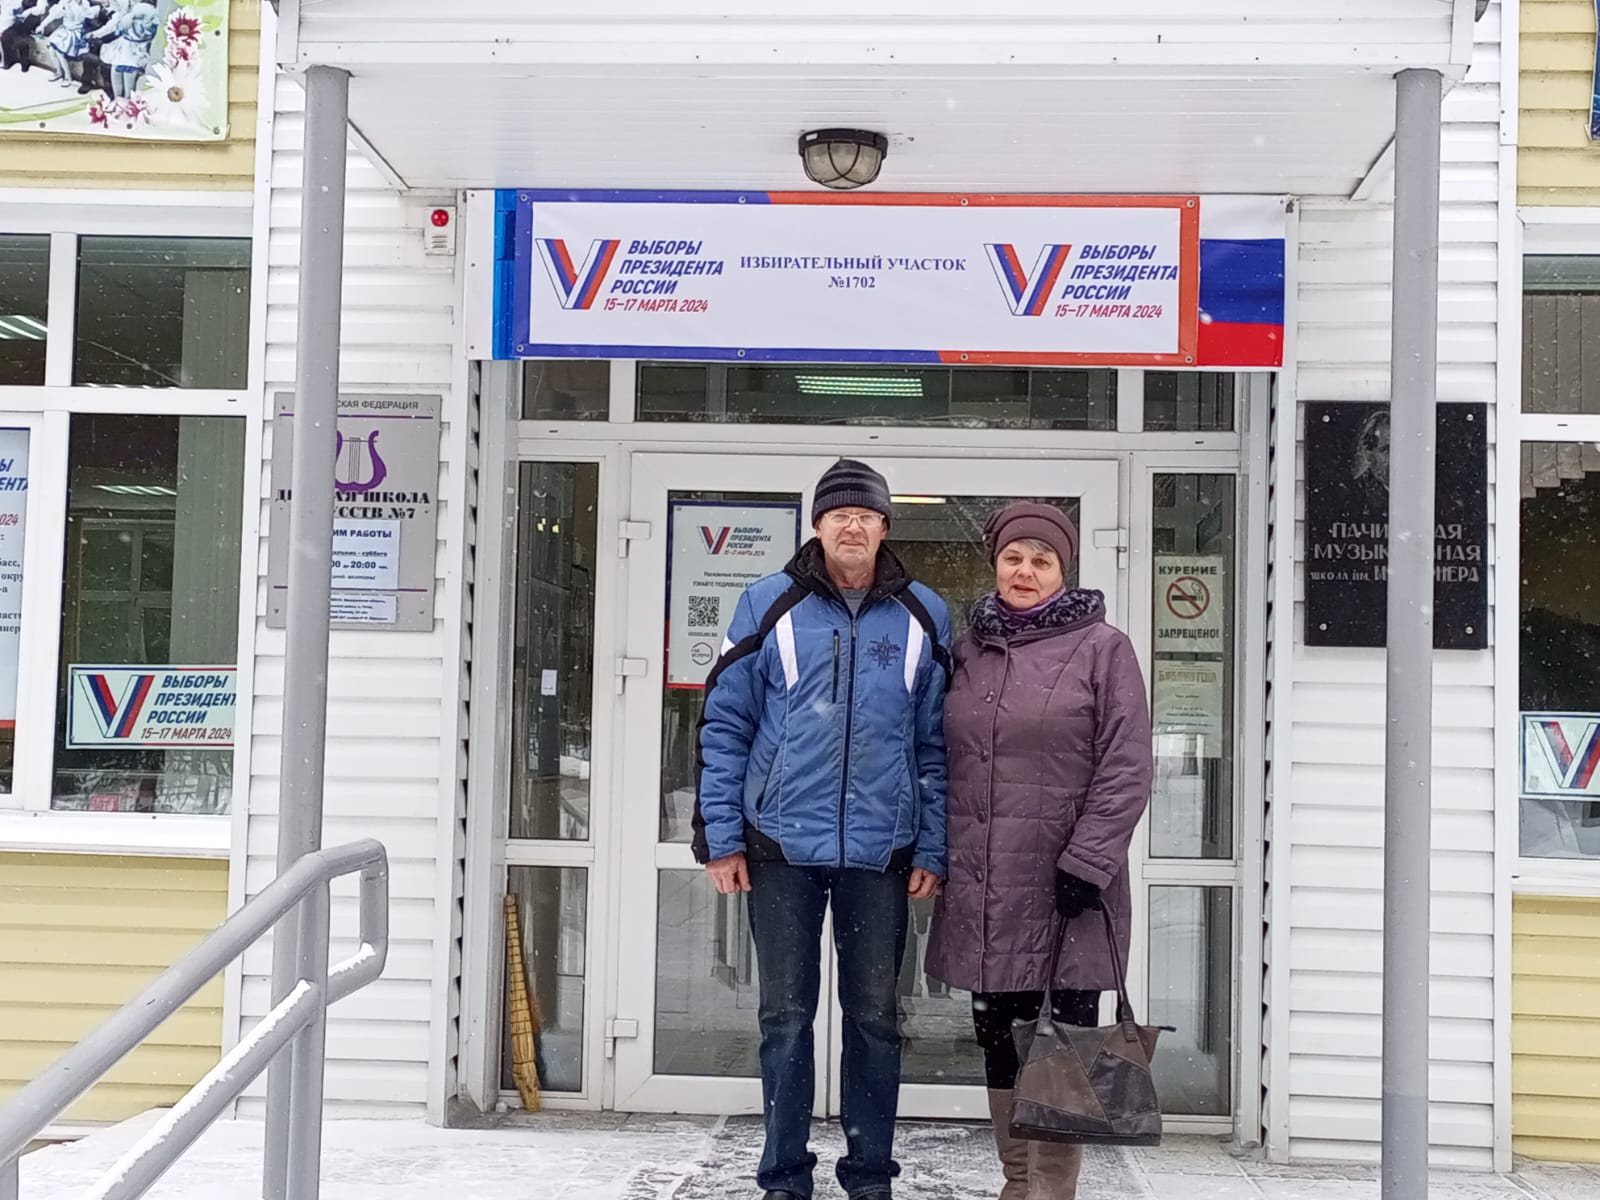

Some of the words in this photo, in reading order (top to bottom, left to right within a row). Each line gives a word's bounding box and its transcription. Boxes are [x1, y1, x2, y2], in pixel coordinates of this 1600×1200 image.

[628, 240, 703, 255] ВЫБОРЫ
[1079, 245, 1157, 260] ВЫБОРЫ
[619, 259, 724, 277] ПРЕЗИДЕНТА
[740, 255, 882, 270] ИЗБИРАТЕЛЬНЫЙ
[888, 258, 966, 271] УЧАСТОК
[1070, 264, 1178, 282] ПРЕЗИДЕНТА
[610, 279, 678, 294] РОССИИ
[828, 276, 876, 288] №1702
[1061, 285, 1132, 300] РОССИИ
[637, 299, 679, 312] МАРТА
[679, 299, 708, 312] 2024
[1089, 304, 1131, 318] МАРТА
[1132, 305, 1162, 318] 2024
[361, 400, 418, 410] ФЕДЕРАЦИЯ
[364, 491, 430, 504] ШКОЛА
[388, 507, 415, 519] №7
[350, 529, 392, 538] РАБОТЫ
[351, 560, 376, 569] 20:00
[1159, 566, 1217, 575] КУРЕНИЕ
[1158, 627, 1219, 640] ЗАПРЕЩЕНО!
[161, 675, 229, 688] ВЫБОРЫ
[154, 693, 237, 707] ПРЕЗИДЕНТ
[146, 710, 207, 724] РОССИИ
[171, 728, 207, 740] МАРТА
[207, 728, 232, 740] 2024
